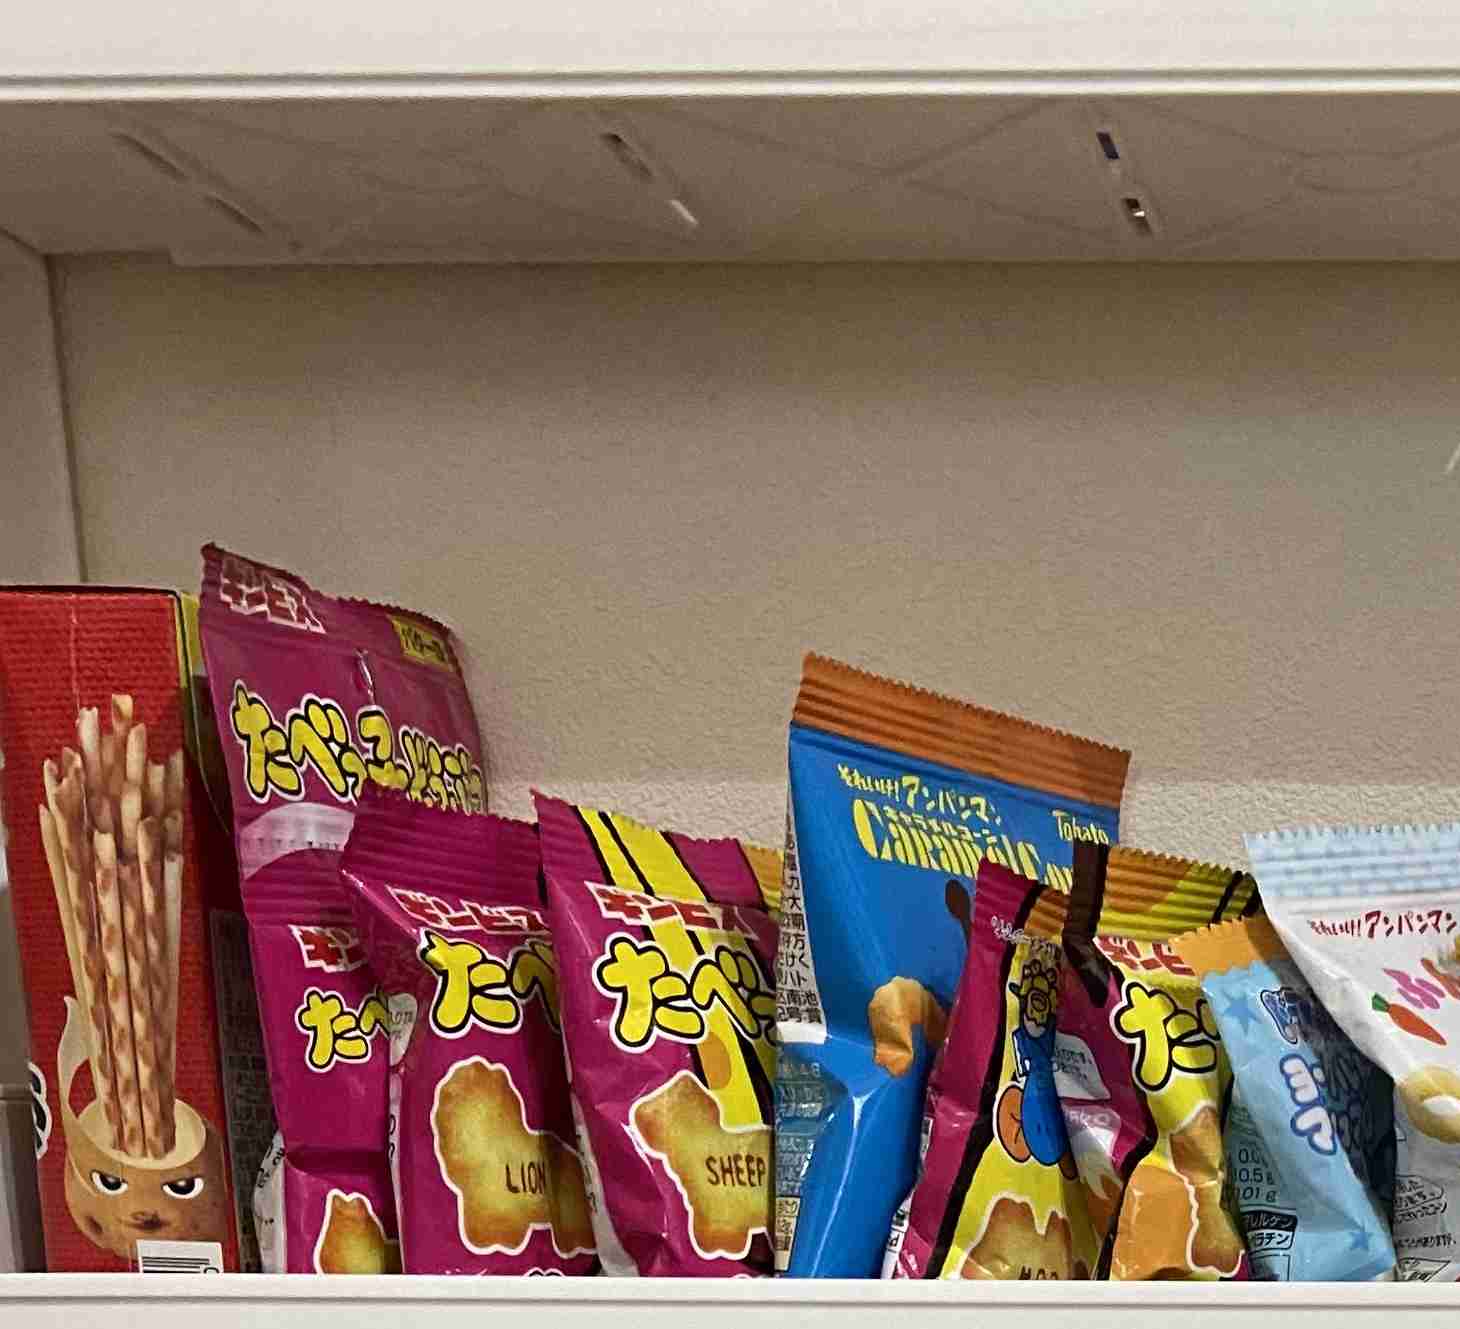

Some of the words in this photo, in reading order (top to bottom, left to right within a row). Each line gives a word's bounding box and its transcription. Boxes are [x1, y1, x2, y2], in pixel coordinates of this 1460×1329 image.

[1052, 808, 1108, 845] Tohato
[506, 1157, 549, 1196] LION
[705, 1154, 767, 1188] SHEEP
